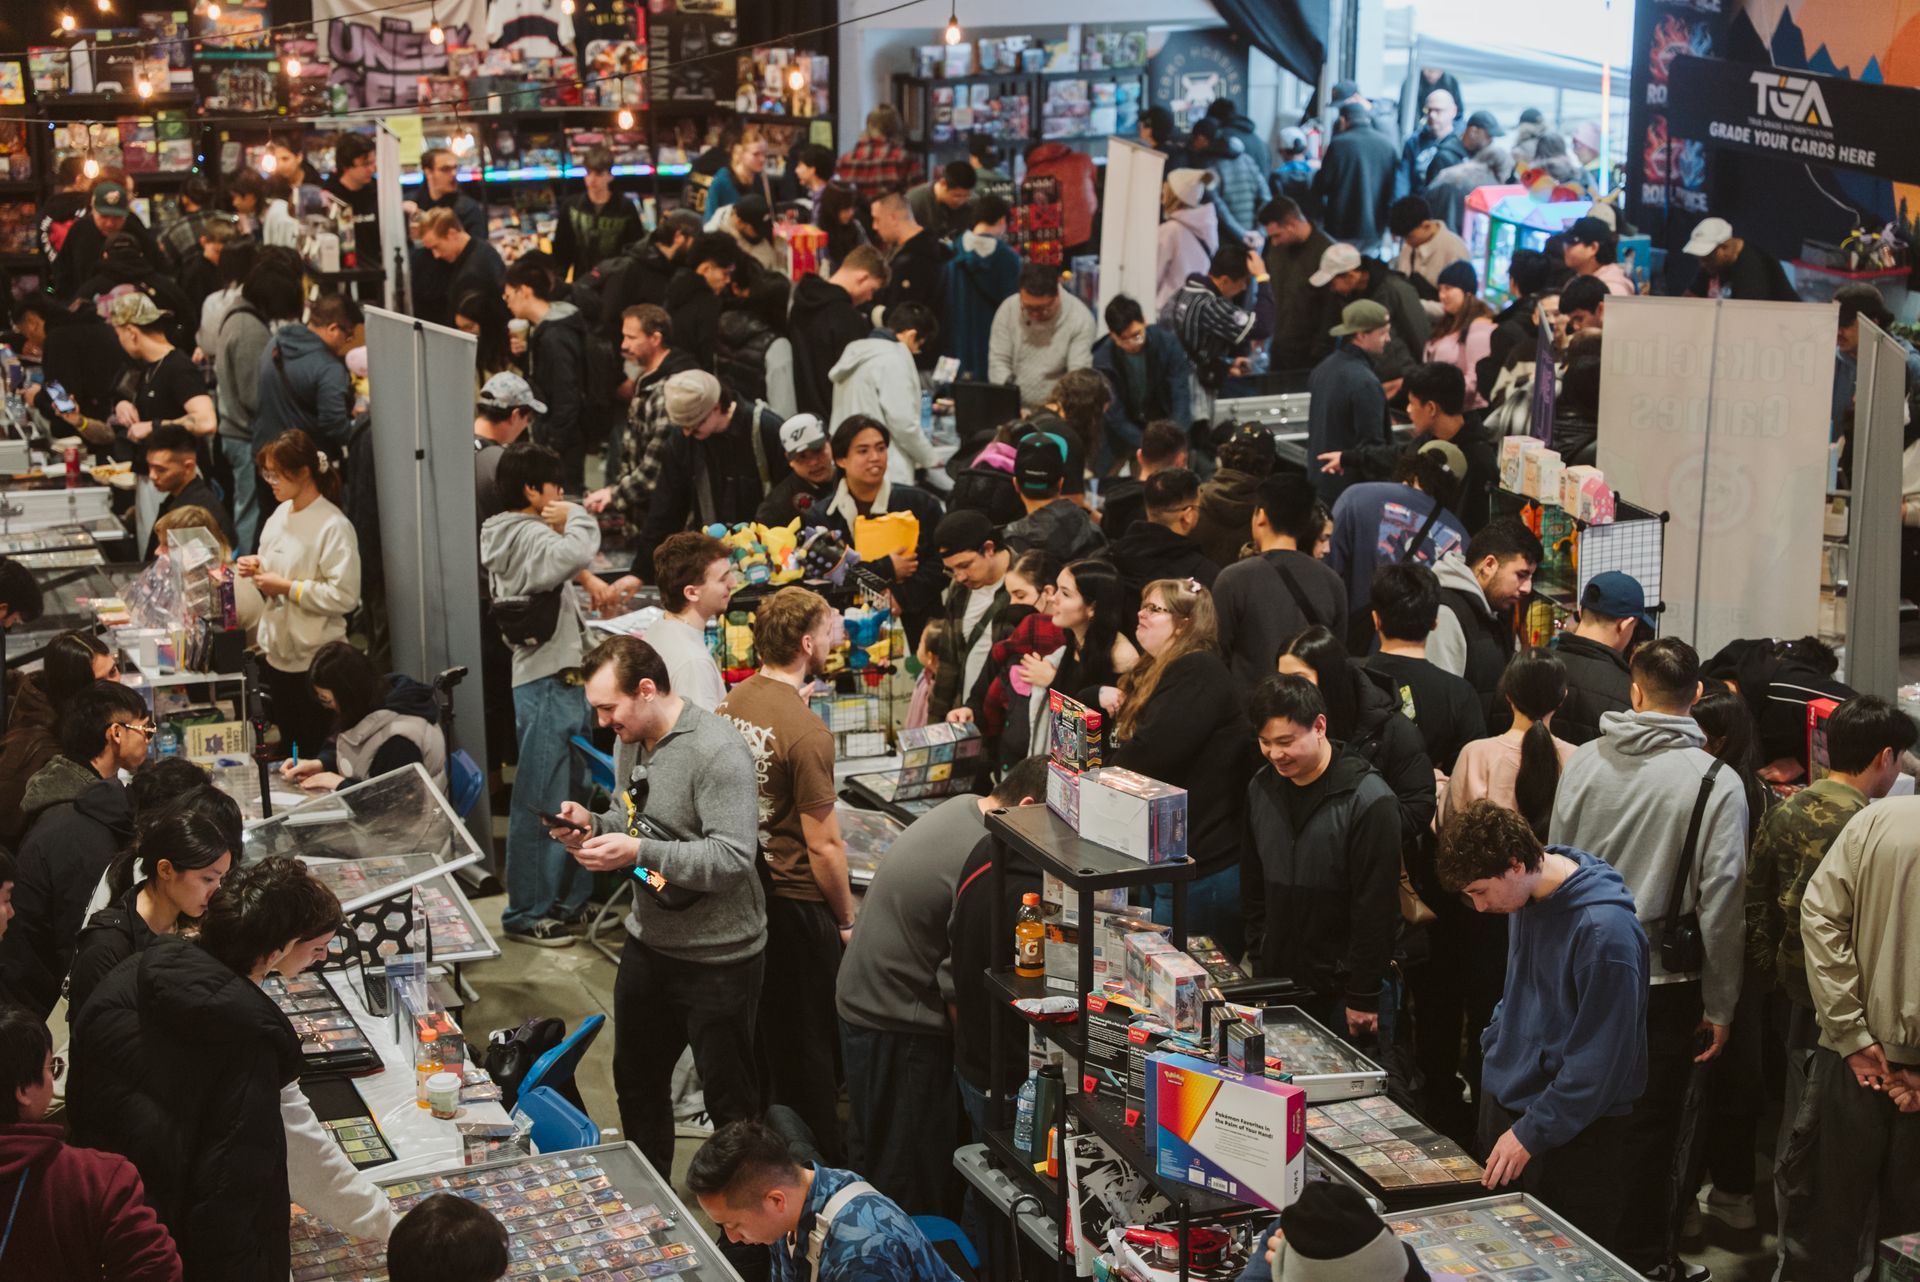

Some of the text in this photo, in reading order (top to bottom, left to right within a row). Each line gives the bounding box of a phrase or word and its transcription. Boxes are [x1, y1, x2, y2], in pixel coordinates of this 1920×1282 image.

[1750, 71, 1833, 127] TGA
[1709, 121, 1876, 167] GRADE YOUR CARDS HERE
[1025, 942, 1038, 956] G
[1215, 1111, 1239, 1122] Pokémon
[1241, 1118, 1264, 1130] Favorites
[1225, 1120, 1238, 1128] Palm
